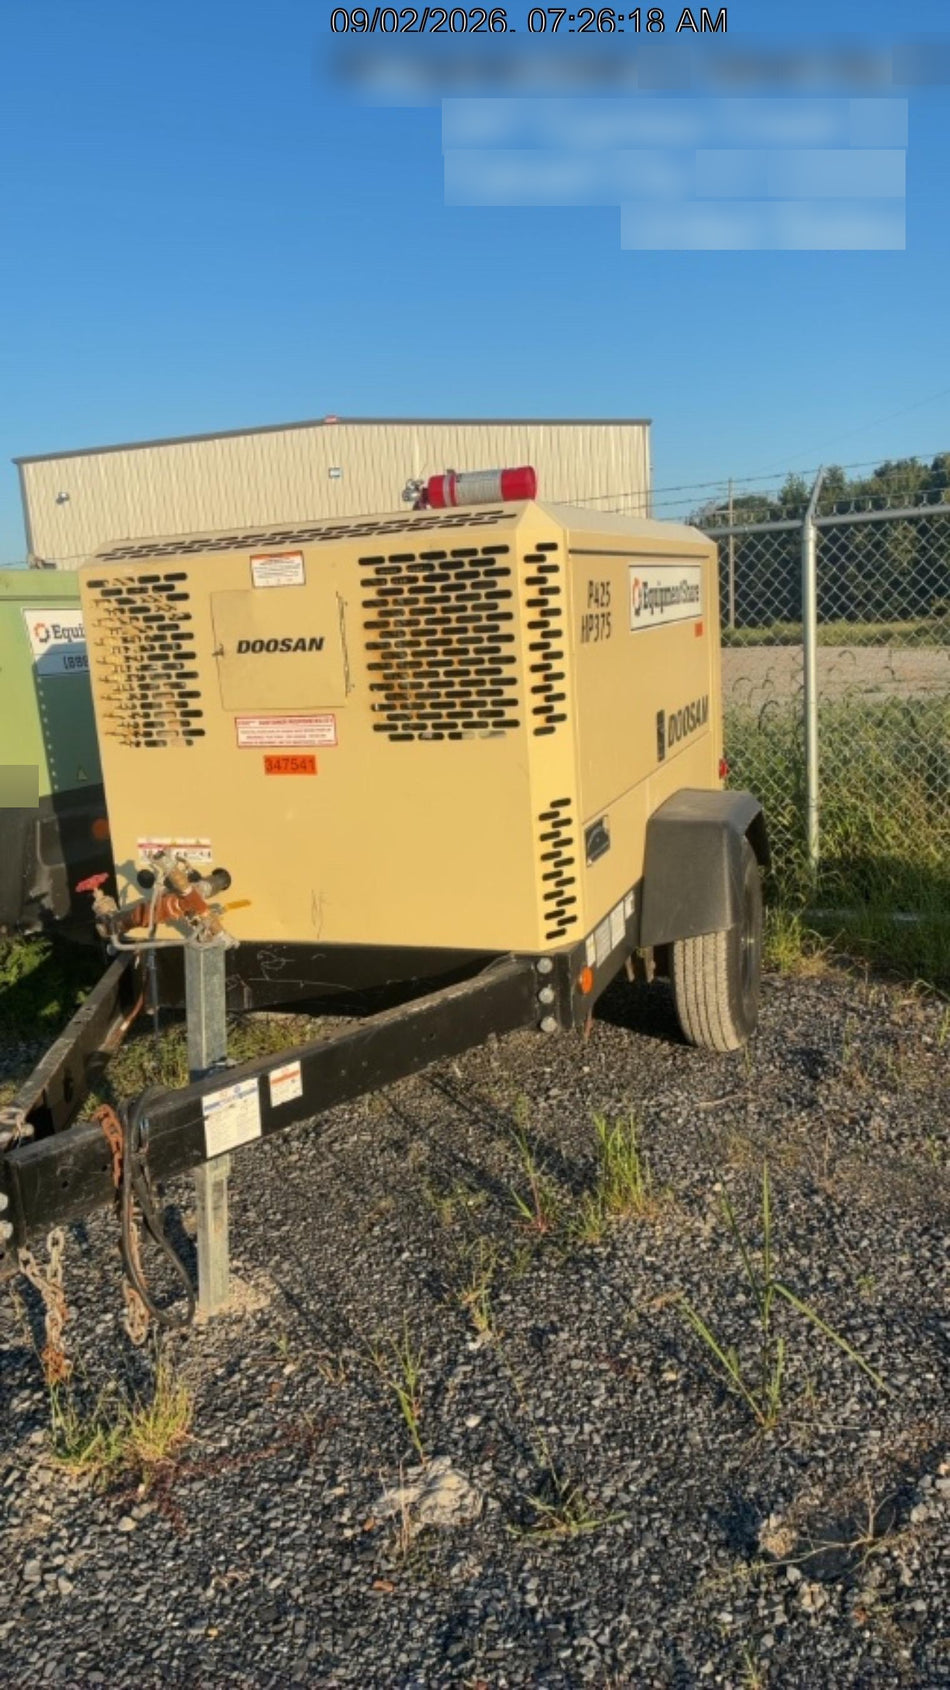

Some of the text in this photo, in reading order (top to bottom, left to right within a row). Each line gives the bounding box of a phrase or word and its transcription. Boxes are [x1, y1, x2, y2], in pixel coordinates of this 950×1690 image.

[587, 580, 611, 609] P425
[581, 612, 612, 644] HP375
[236, 636, 325, 655] DOOSAN
[668, 695, 709, 748] DOOSAN
[265, 757, 316, 772] 347541
